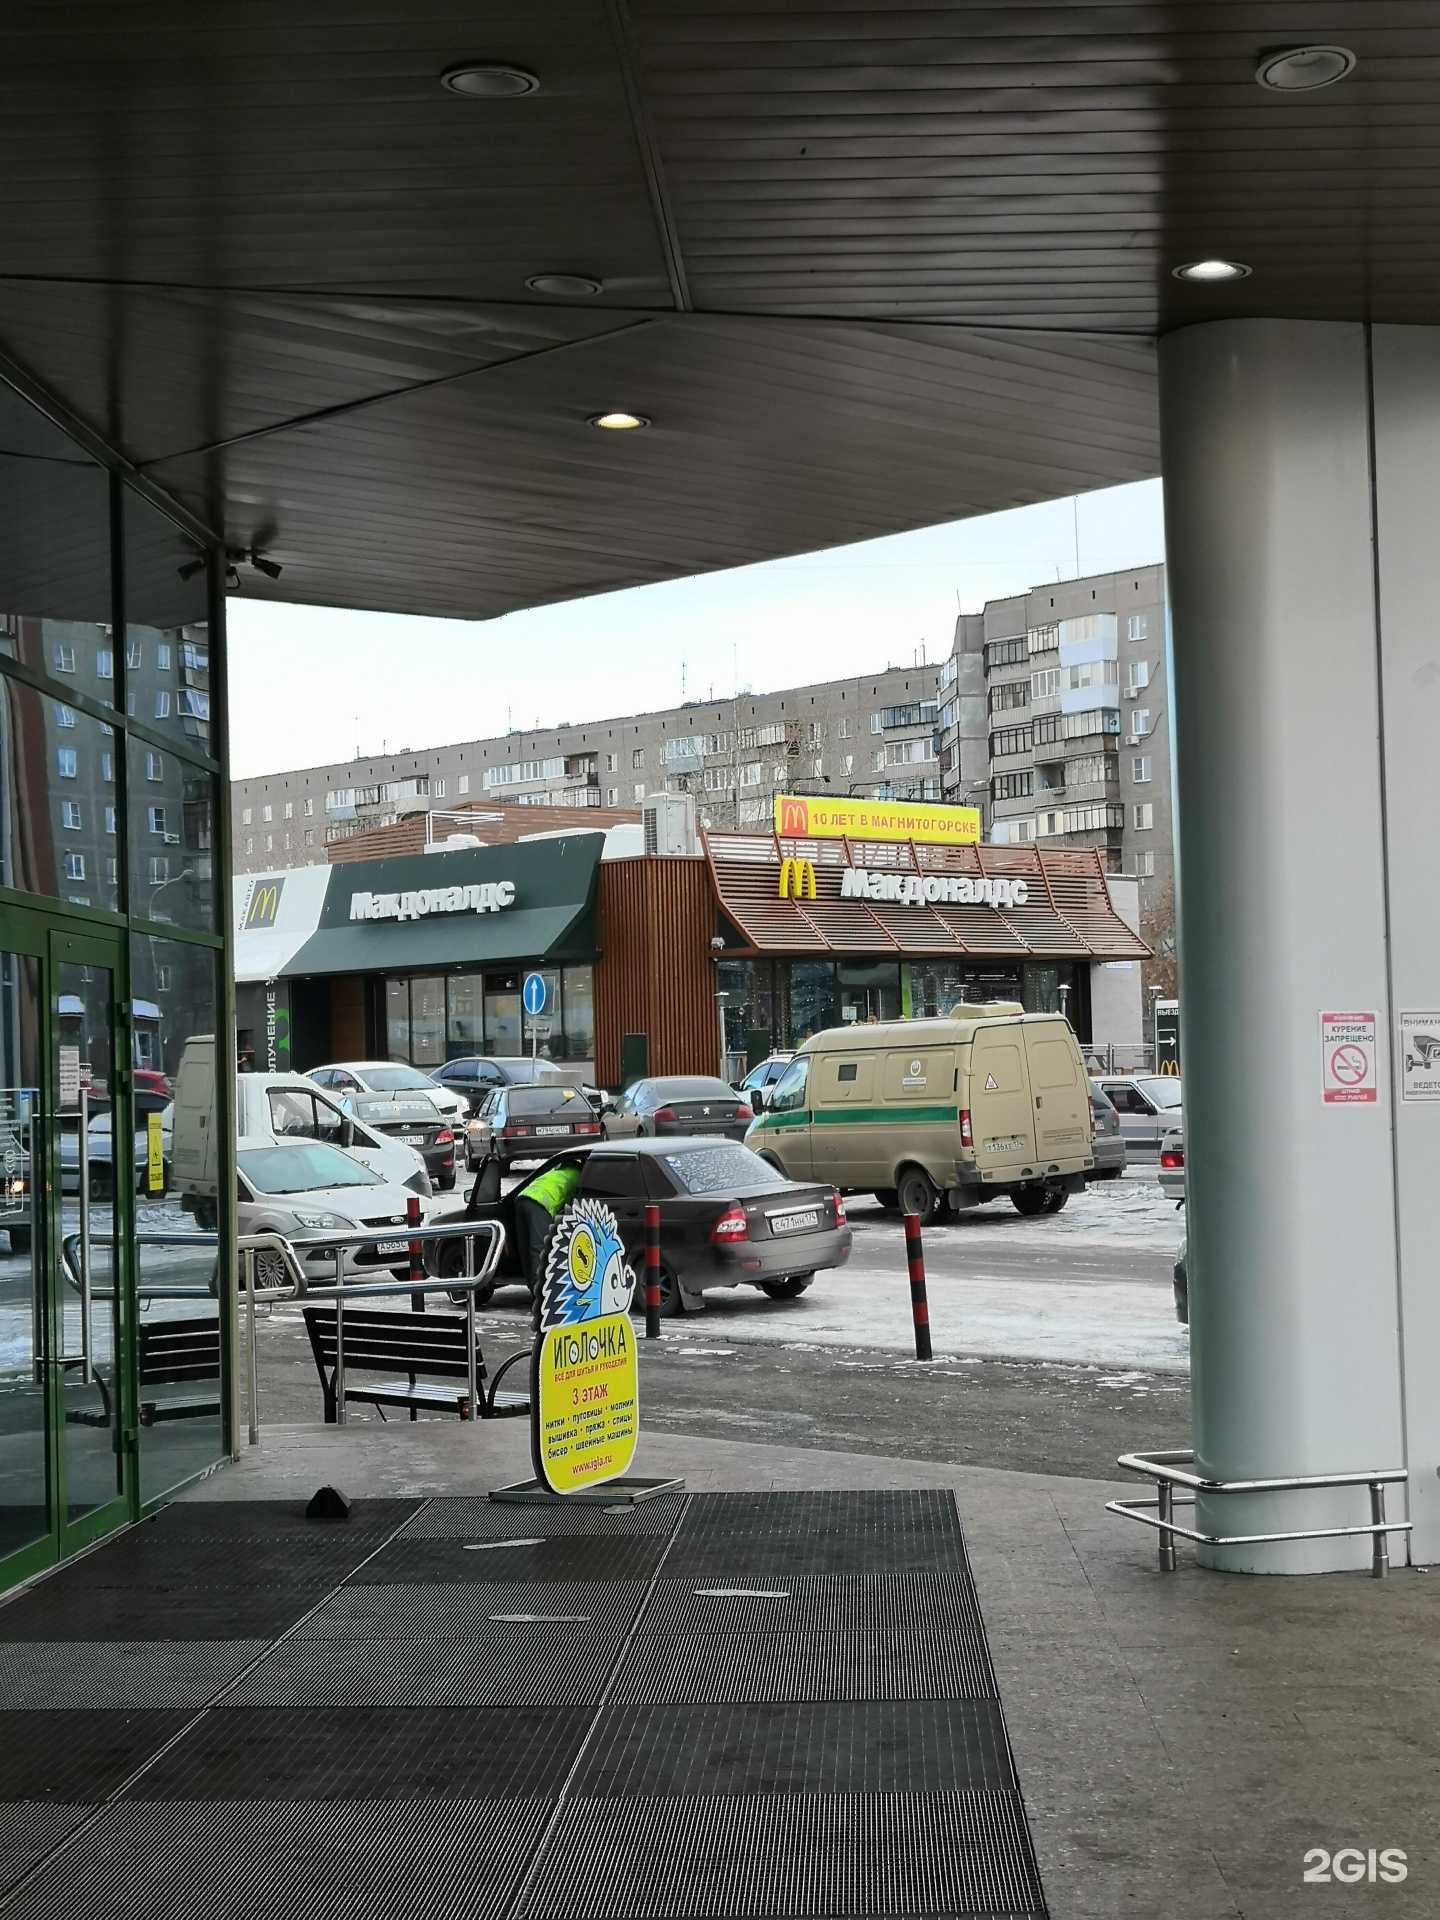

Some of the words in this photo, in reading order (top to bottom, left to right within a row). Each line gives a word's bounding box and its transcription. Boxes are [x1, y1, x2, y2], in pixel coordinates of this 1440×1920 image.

[813, 813, 828, 825] 10
[831, 814, 855, 826] ЛЕТ
[860, 815, 868, 826] В
[871, 815, 977, 834] МАГНИТОГОРСКЕ
[840, 868, 1029, 908] Макдоналдс
[349, 881, 516, 921] Макдоналдс
[1325, 1034, 1374, 1042] ЗАПРЕЩЕНО
[1331, 1025, 1367, 1033] КУРЕНИЕ
[577, 1366, 594, 1377] ШИТЬЯ
[573, 1387, 578, 1405] 3
[582, 1383, 608, 1402] ЭТАЖ
[546, 1417, 565, 1429] нитки
[572, 1407, 603, 1424] пуговицы
[548, 1428, 578, 1444] вышивка
[585, 1421, 605, 1435] пряжа
[612, 1414, 632, 1426] спицы
[548, 1446, 569, 1459] бисер
[575, 1435, 605, 1450] швейные
[608, 1427, 632, 1440] машины
